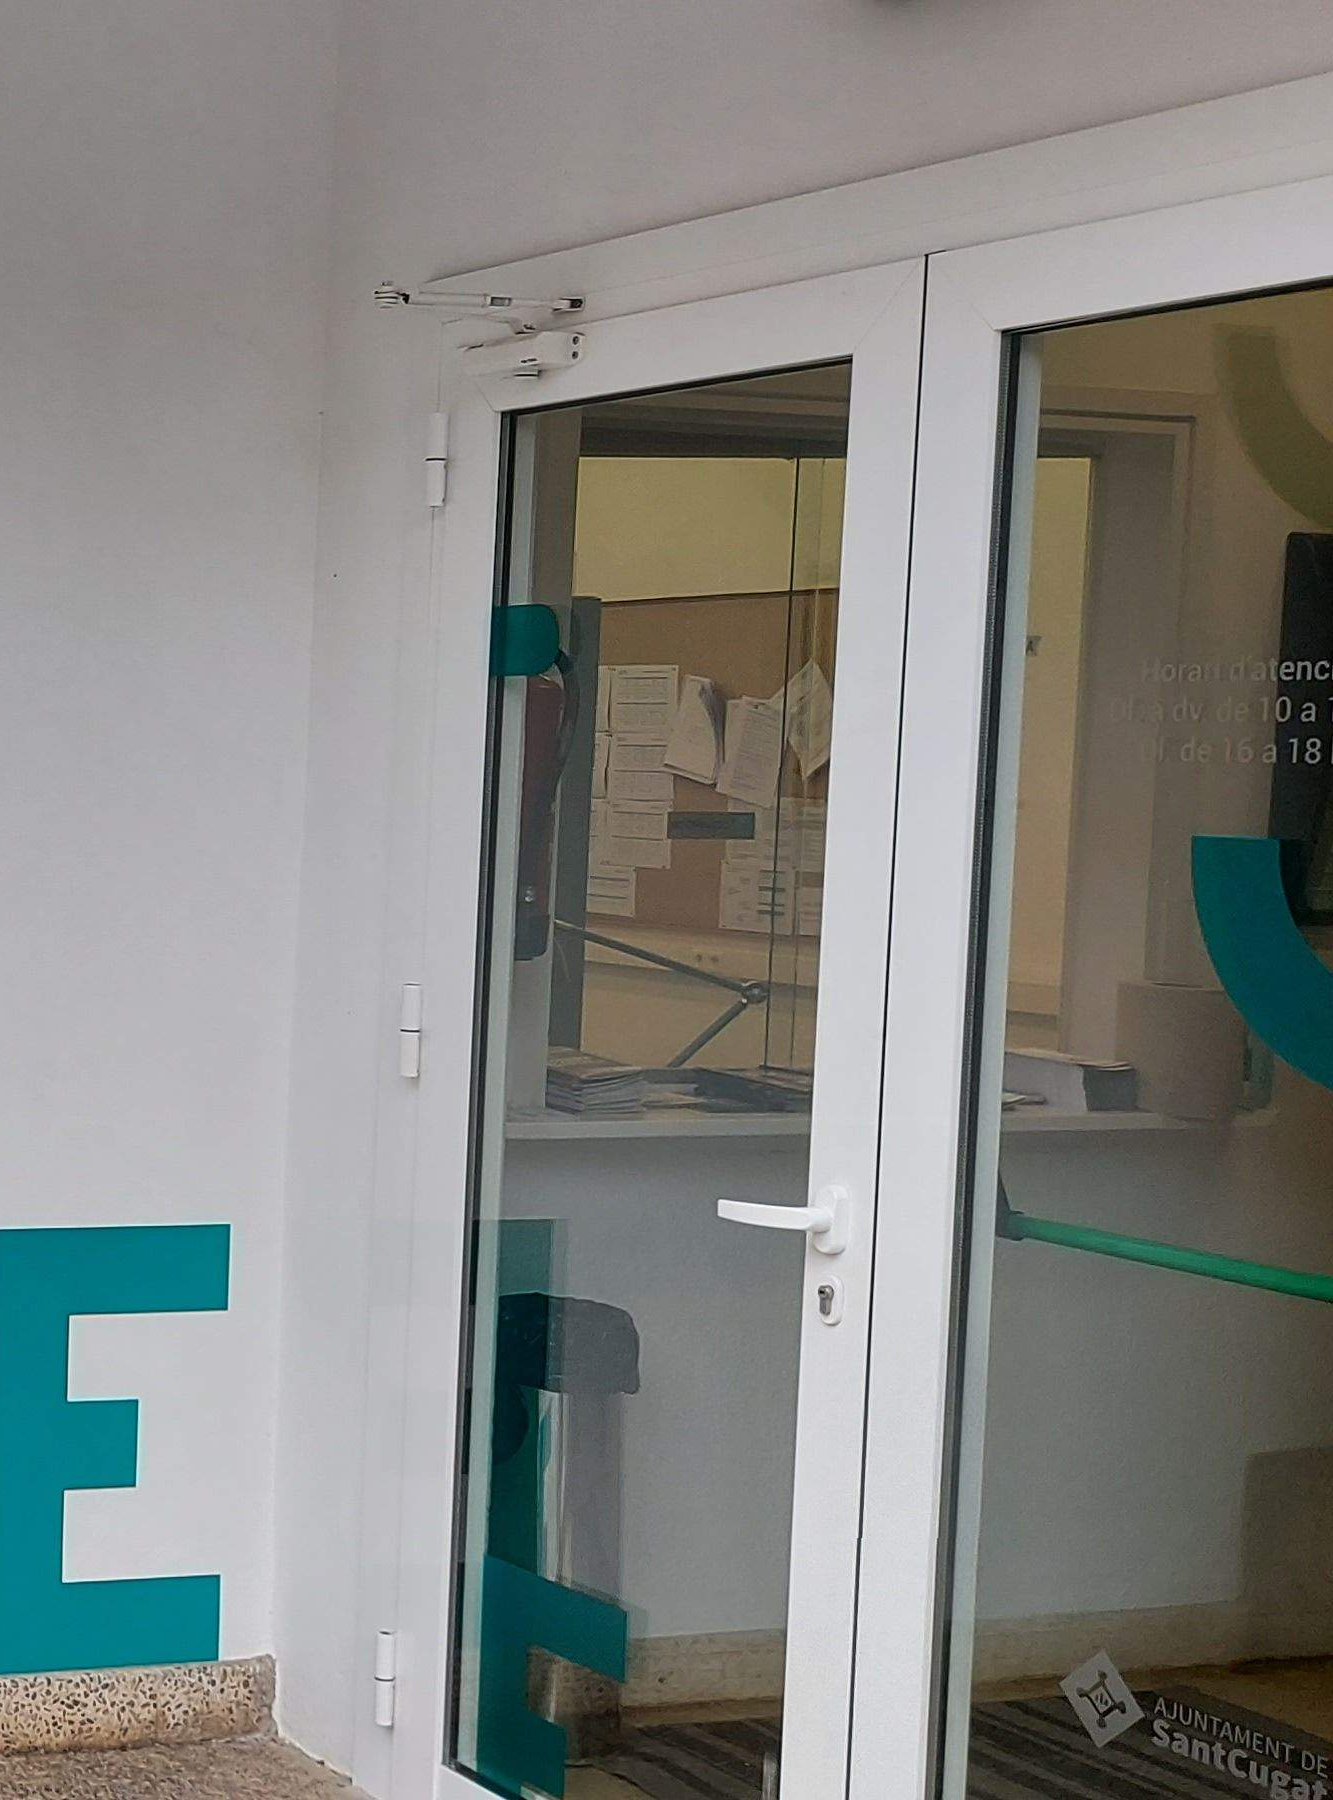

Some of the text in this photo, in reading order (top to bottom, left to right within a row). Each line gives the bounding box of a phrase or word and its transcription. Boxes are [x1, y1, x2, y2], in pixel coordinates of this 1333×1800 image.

[1229, 655, 1333, 682] d'atenc
[1261, 696, 1292, 722] 10
[1300, 702, 1316, 722] a
[1180, 736, 1213, 763] de
[1224, 737, 1255, 764] 16
[1261, 743, 1277, 764] a
[1288, 738, 1321, 764] 18
[1153, 1696, 1329, 1779] AJUNTAMENT DE
